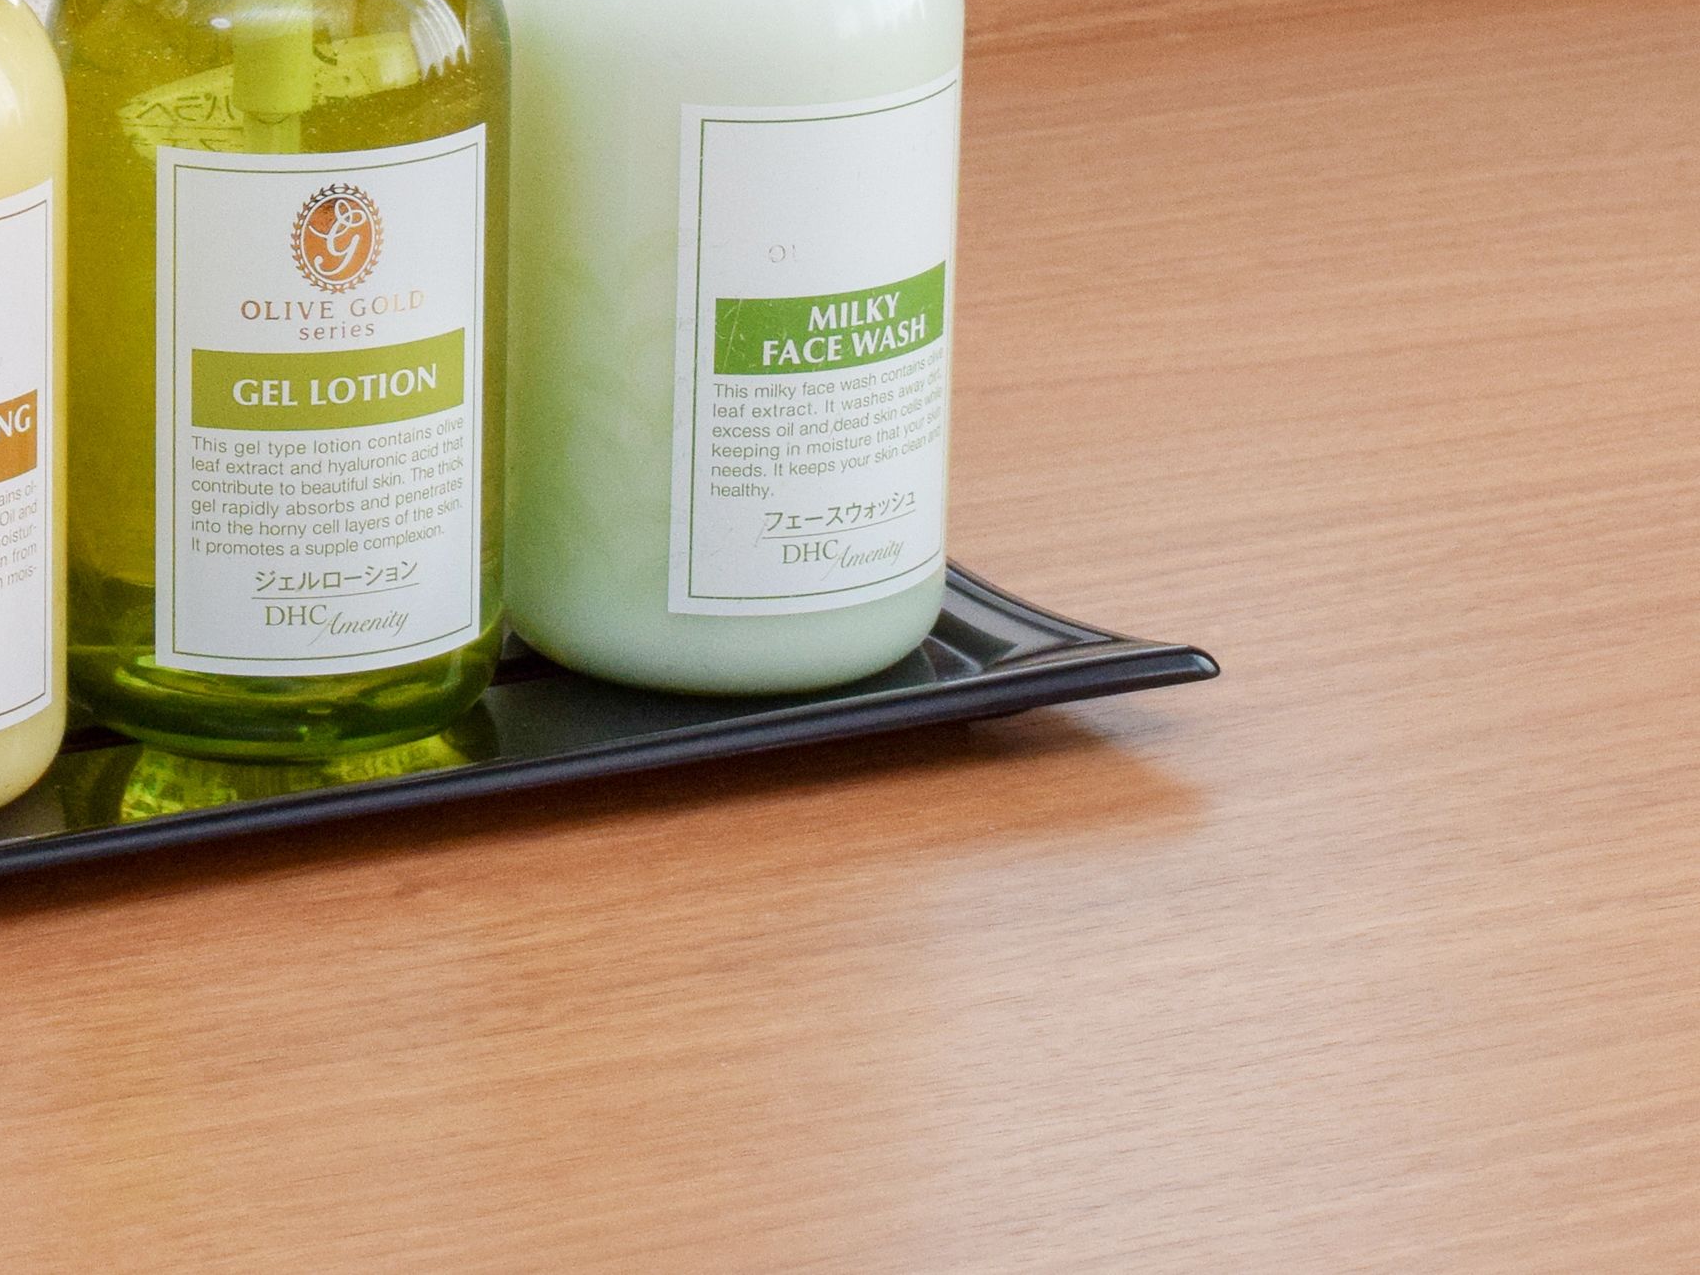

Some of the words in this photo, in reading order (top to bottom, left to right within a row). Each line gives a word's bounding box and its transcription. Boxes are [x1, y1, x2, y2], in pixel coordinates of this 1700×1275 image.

[241, 300, 334, 321] OLIVE
[350, 290, 425, 317] GOLD
[808, 291, 900, 331] MILKY
[299, 321, 375, 341] series
[763, 335, 842, 366] FACE
[851, 314, 926, 357] WASH
[232, 379, 297, 406] GEL
[310, 363, 437, 406] LOTION
[713, 384, 748, 399] This
[754, 384, 796, 401] milky
[802, 381, 835, 395] face
[839, 375, 876, 392] wash
[881, 358, 925, 384] contains
[713, 404, 744, 418] leaf
[752, 404, 817, 417] extract.
[825, 400, 834, 413] It
[841, 392, 894, 411] washes
[192, 435, 227, 453] This
[234, 440, 260, 457] gel
[268, 440, 306, 458] type
[313, 438, 361, 453] lotion
[368, 425, 432, 450] contains
[437, 416, 464, 436] olive
[712, 425, 770, 438] excess
[777, 423, 793, 437] oil
[800, 421, 828, 435] and
[834, 414, 869, 433] dead
[873, 410, 897, 425] skin
[192, 457, 220, 472] leaf
[226, 461, 283, 476] extract
[291, 460, 321, 475] and
[329, 453, 407, 476] hyaluronic
[412, 445, 438, 462] acid
[442, 436, 464, 454] that
[711, 463, 767, 477] needs.
[774, 463, 782, 476] It
[789, 459, 835, 477] keeps
[840, 454, 870, 473] your
[874, 446, 898, 463] skin
[712, 443, 780, 461] keeping
[787, 443, 800, 456] in
[806, 434, 871, 454] moisture
[876, 427, 900, 443] that
[192, 479, 273, 495] contribute
[280, 482, 295, 496] to
[301, 477, 368, 495] beautiful
[411, 465, 434, 481] The
[438, 457, 464, 476] thick
[711, 483, 774, 499] healthy.
[192, 498, 216, 514] gel
[222, 500, 279, 518] rapidly
[286, 497, 354, 516] absorbs
[361, 492, 389, 510] and
[395, 476, 463, 505] penetrates
[765, 491, 916, 531] フェースウォッシュ
[0, 510, 15, 526] Oil
[192, 519, 221, 533] into
[228, 519, 253, 534] the
[259, 522, 306, 538] horny
[313, 519, 340, 535] cell
[345, 513, 389, 533] layers
[395, 510, 410, 526] of
[413, 504, 434, 522] the
[12, 543, 37, 564] from
[192, 537, 201, 552] It
[206, 539, 285, 557] promotes
[290, 542, 299, 556] a
[305, 536, 359, 557] supple
[363, 522, 445, 551] complexion.
[255, 561, 418, 592] ジェルローション
[782, 540, 838, 564] DHC
[820, 539, 904, 581] Amenity
[265, 605, 327, 626] DHC
[308, 610, 410, 646] Amenity
